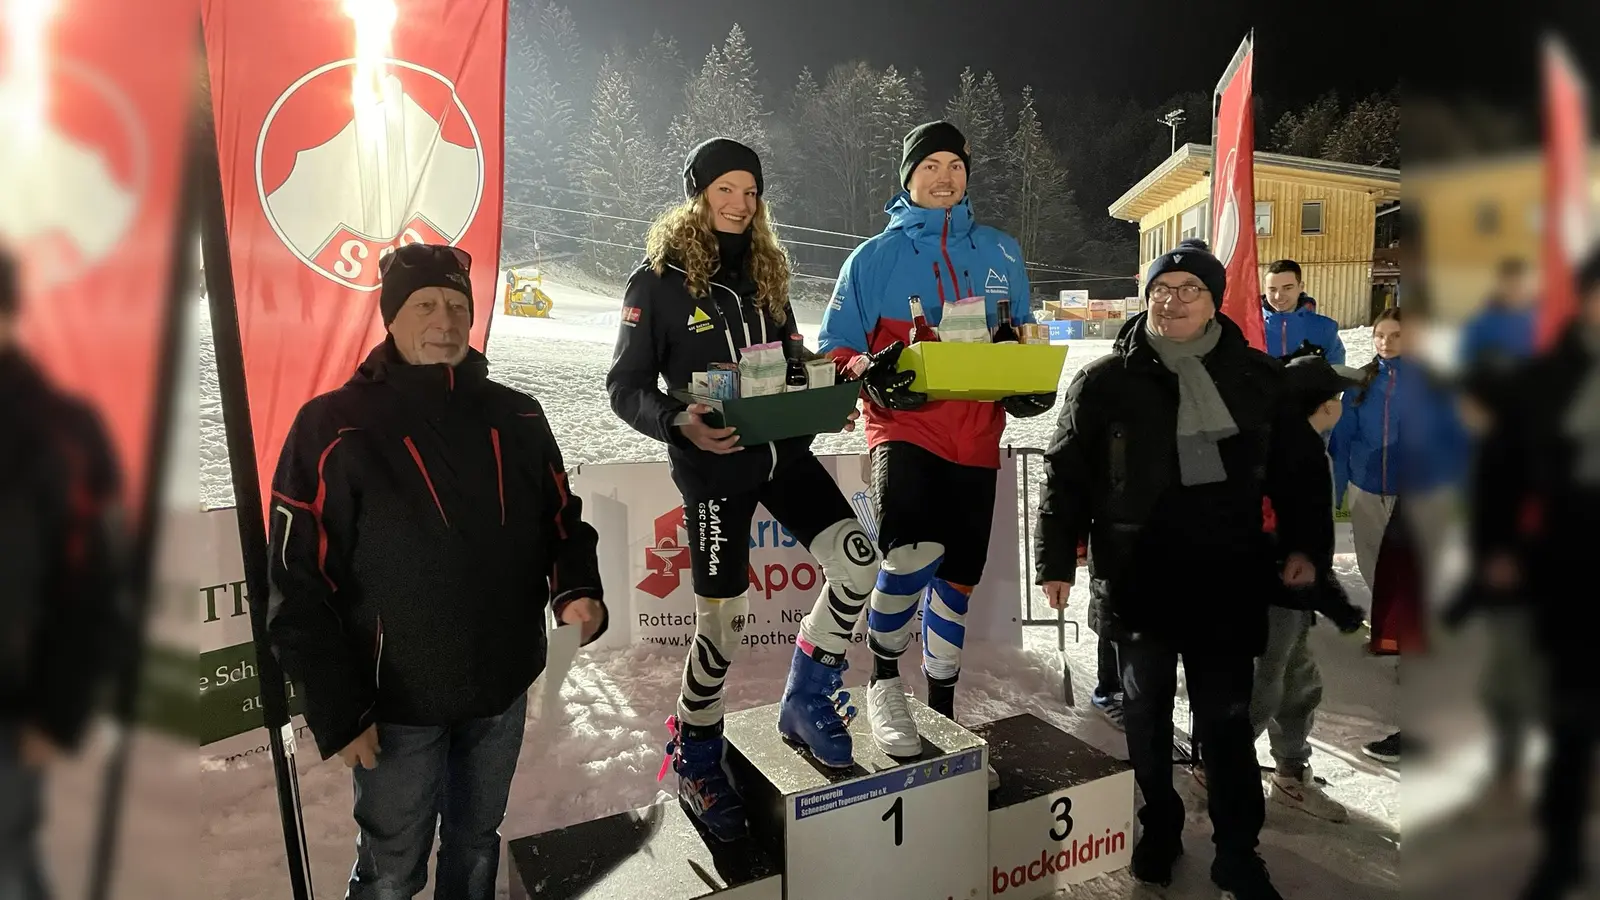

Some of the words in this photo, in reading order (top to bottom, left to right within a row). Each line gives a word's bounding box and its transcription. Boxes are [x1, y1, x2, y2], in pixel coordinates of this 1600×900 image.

[708, 498, 728, 576] ennteam
[749, 520, 798, 549] ris
[852, 537, 871, 559] B
[781, 609, 810, 624] Nö
[741, 631, 797, 648] apothe
[216, 660, 258, 687] Sch
[242, 694, 264, 712] au
[800, 789, 843, 807] Förderverein
[801, 799, 838, 817] Schneesport
[838, 792, 870, 808] Tegernseer
[881, 796, 903, 847] 1
[1048, 796, 1074, 842] 3
[992, 828, 1125, 895] backaldrin
